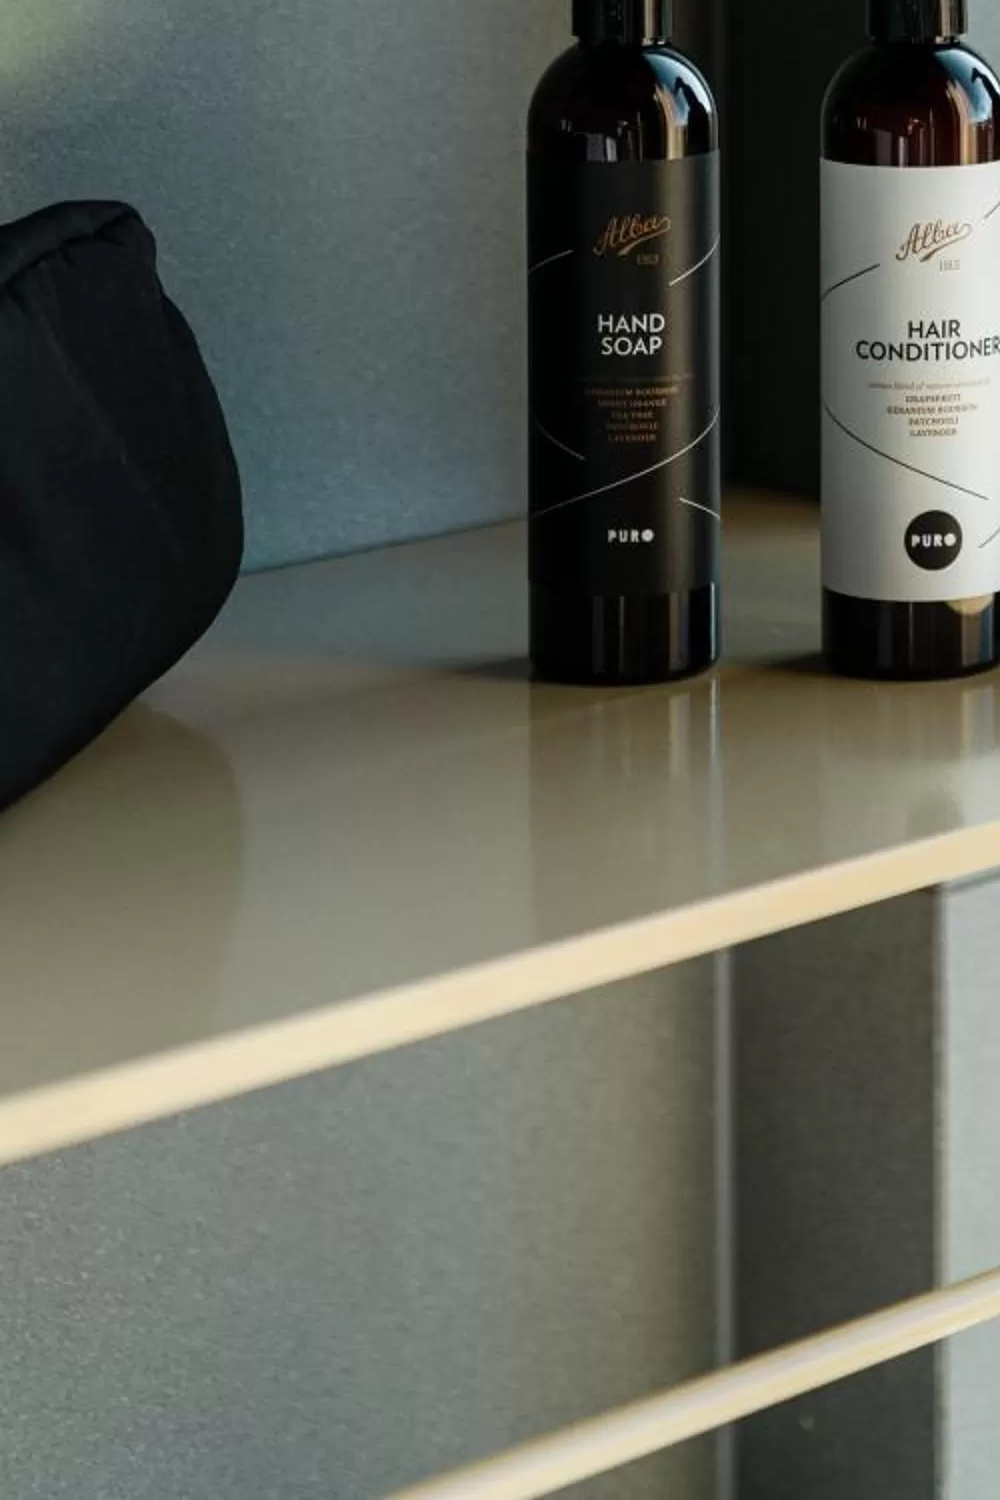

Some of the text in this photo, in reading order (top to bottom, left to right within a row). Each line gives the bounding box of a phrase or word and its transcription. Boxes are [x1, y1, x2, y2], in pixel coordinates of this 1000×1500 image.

[598, 313, 665, 334] HAND
[908, 319, 961, 339] HAIR
[601, 336, 663, 356] SOAP
[855, 336, 1000, 362] CONDITIONER
[607, 528, 655, 544] PURO
[911, 533, 958, 549] PURO
